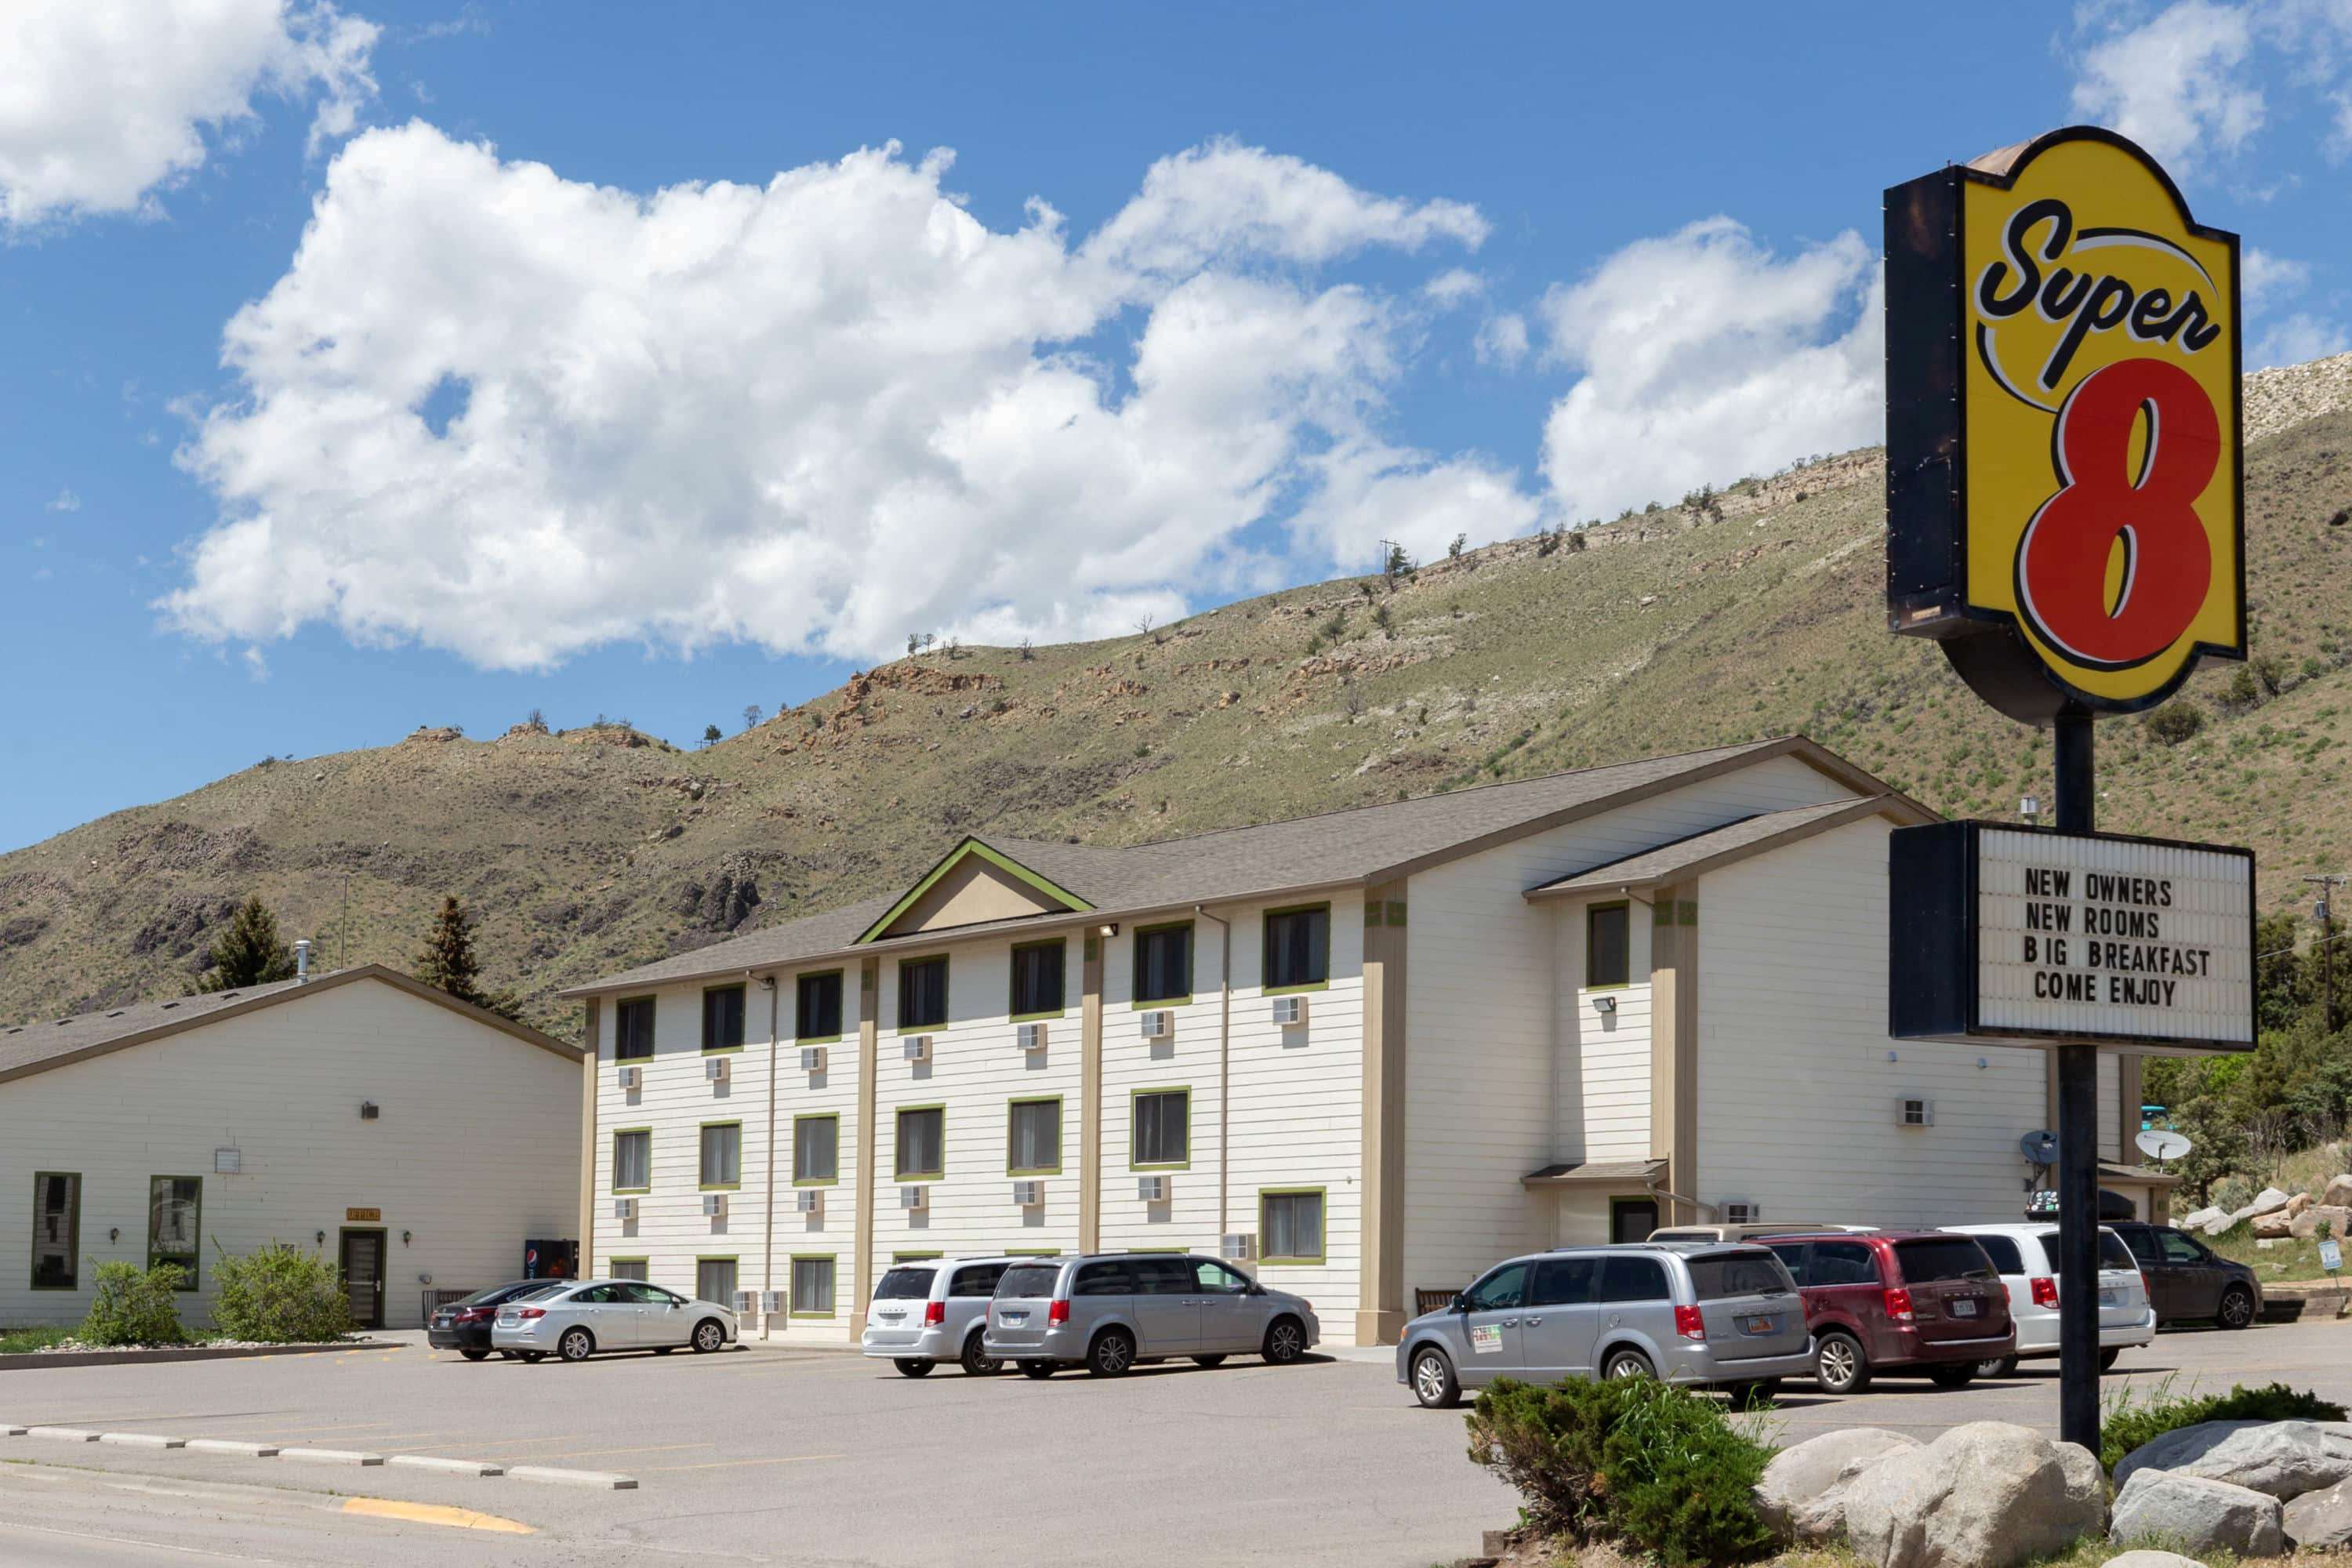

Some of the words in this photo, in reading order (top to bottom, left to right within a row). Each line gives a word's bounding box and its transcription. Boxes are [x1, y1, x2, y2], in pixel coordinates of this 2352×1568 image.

[1974, 198, 2221, 391] Super
[2016, 358, 2220, 668] 8
[2025, 867, 2071, 898] NEW
[2085, 873, 2172, 907] OWNERS
[2026, 902, 2072, 932] NEW
[2084, 906, 2159, 939] ROOMS
[2024, 935, 2067, 967] BIG
[2088, 940, 2210, 977] BREAKFAST
[2034, 971, 2096, 1002] COME
[2110, 975, 2176, 1007] ENJOY
